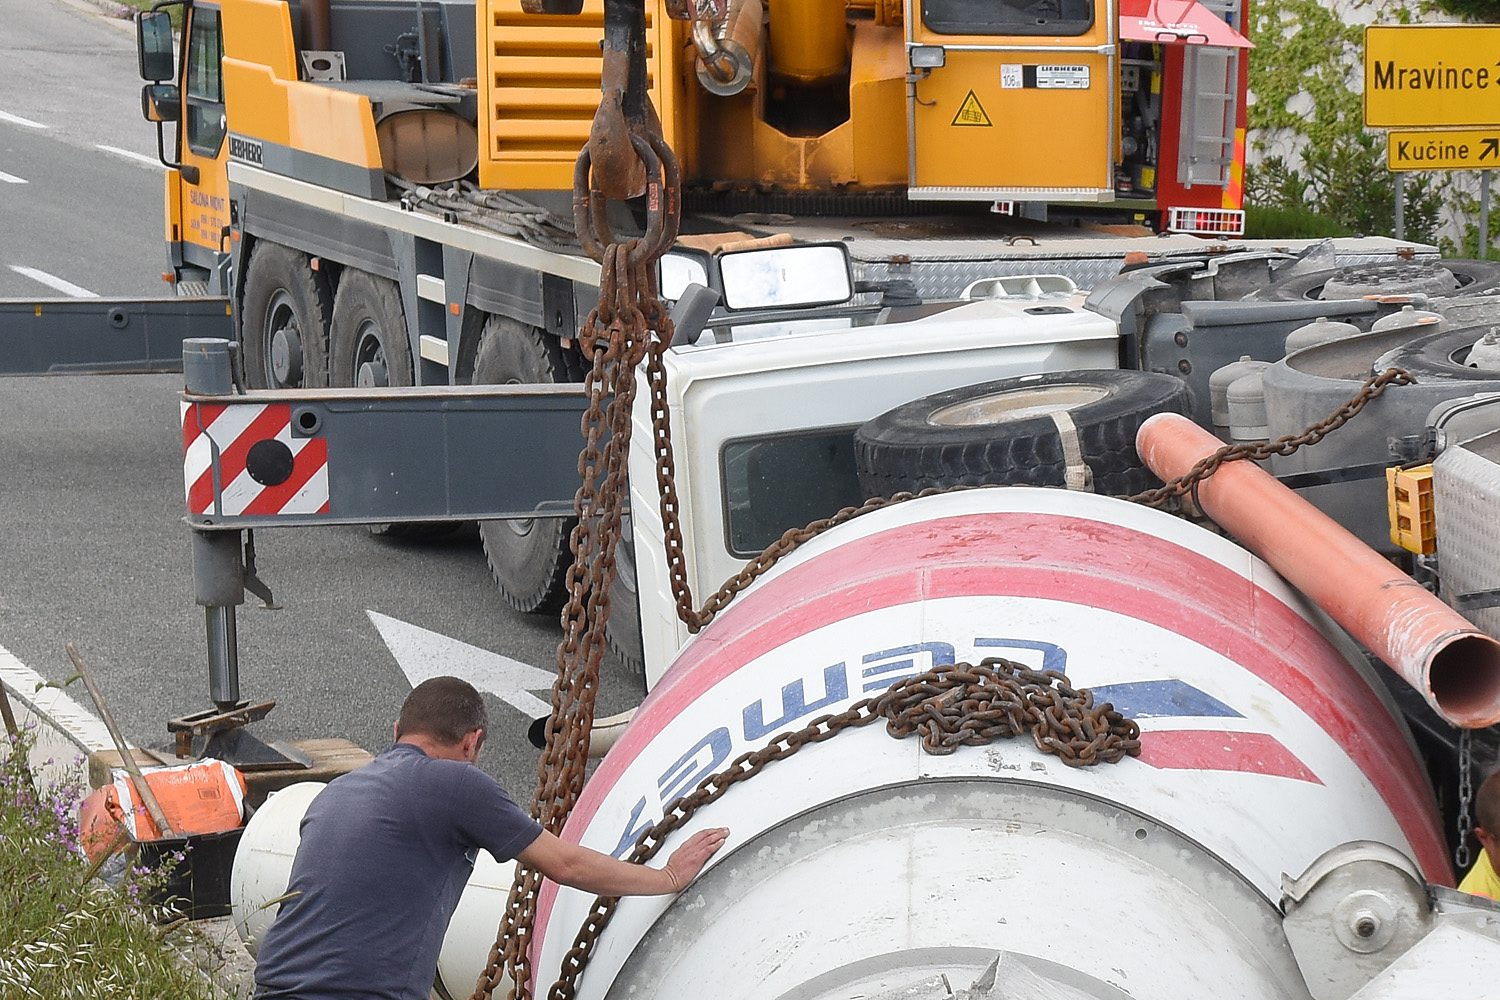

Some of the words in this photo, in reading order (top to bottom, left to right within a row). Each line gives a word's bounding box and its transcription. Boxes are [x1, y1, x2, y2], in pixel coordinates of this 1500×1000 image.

[1374, 60, 1489, 90] Mravince
[229, 136, 263, 164] LIEBHERR
[1397, 140, 1469, 161] Kučine
